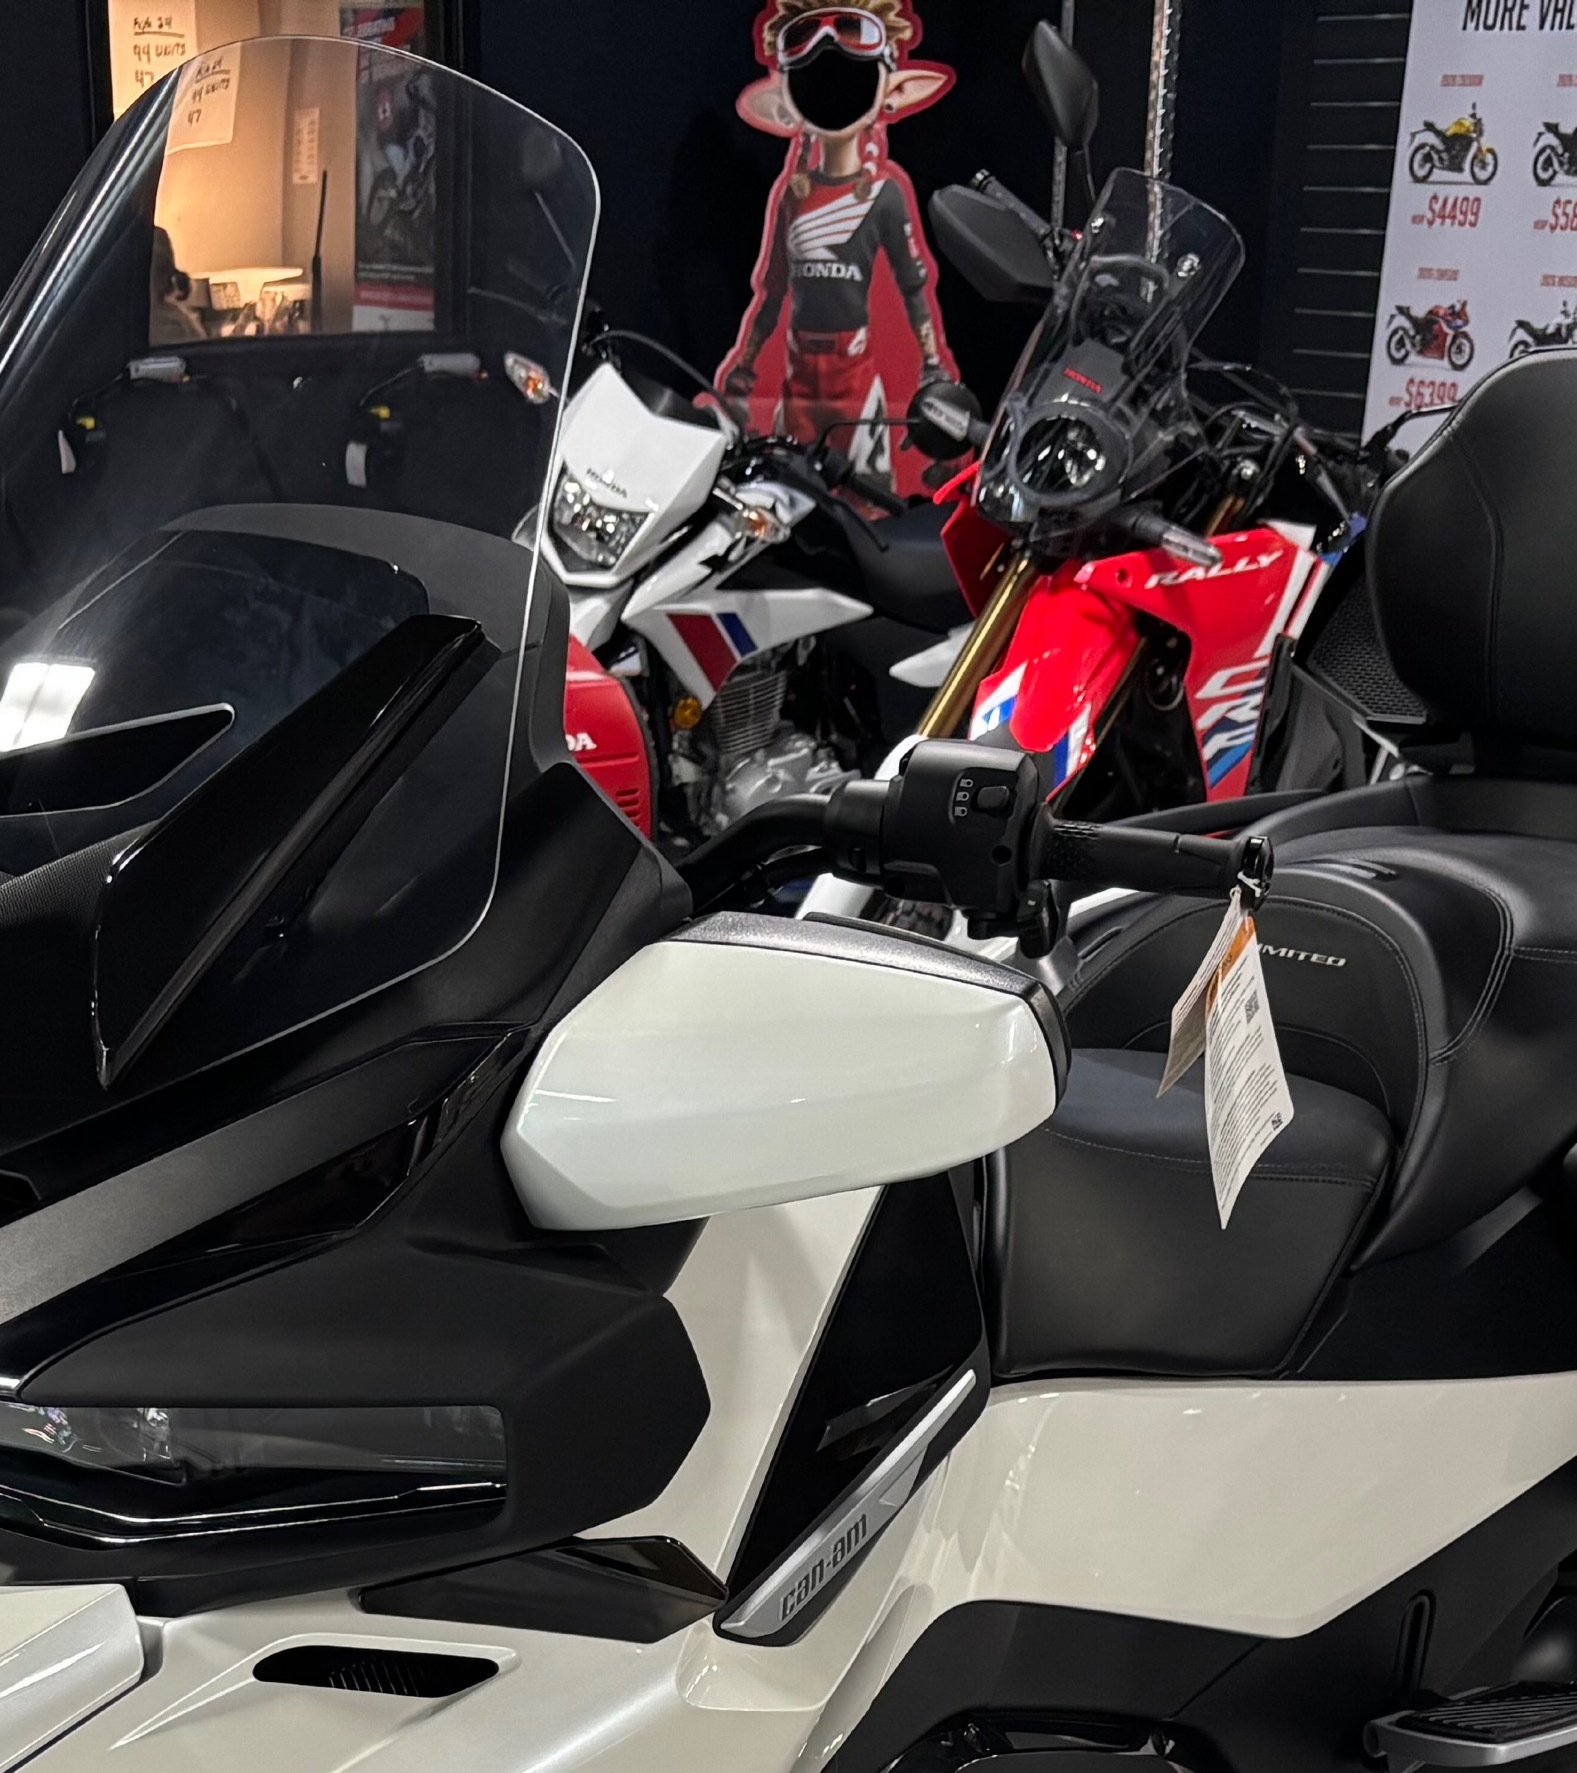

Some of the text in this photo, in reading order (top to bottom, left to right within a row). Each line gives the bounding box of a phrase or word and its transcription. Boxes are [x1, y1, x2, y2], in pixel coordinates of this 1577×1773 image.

[1462, 0, 1529, 31] MORE
[1426, 193, 1482, 229] $4499
[792, 262, 864, 282] HONDA
[1404, 376, 1459, 410] $6399
[1144, 549, 1284, 590] RALLY
[781, 1513, 867, 1621] can-am
